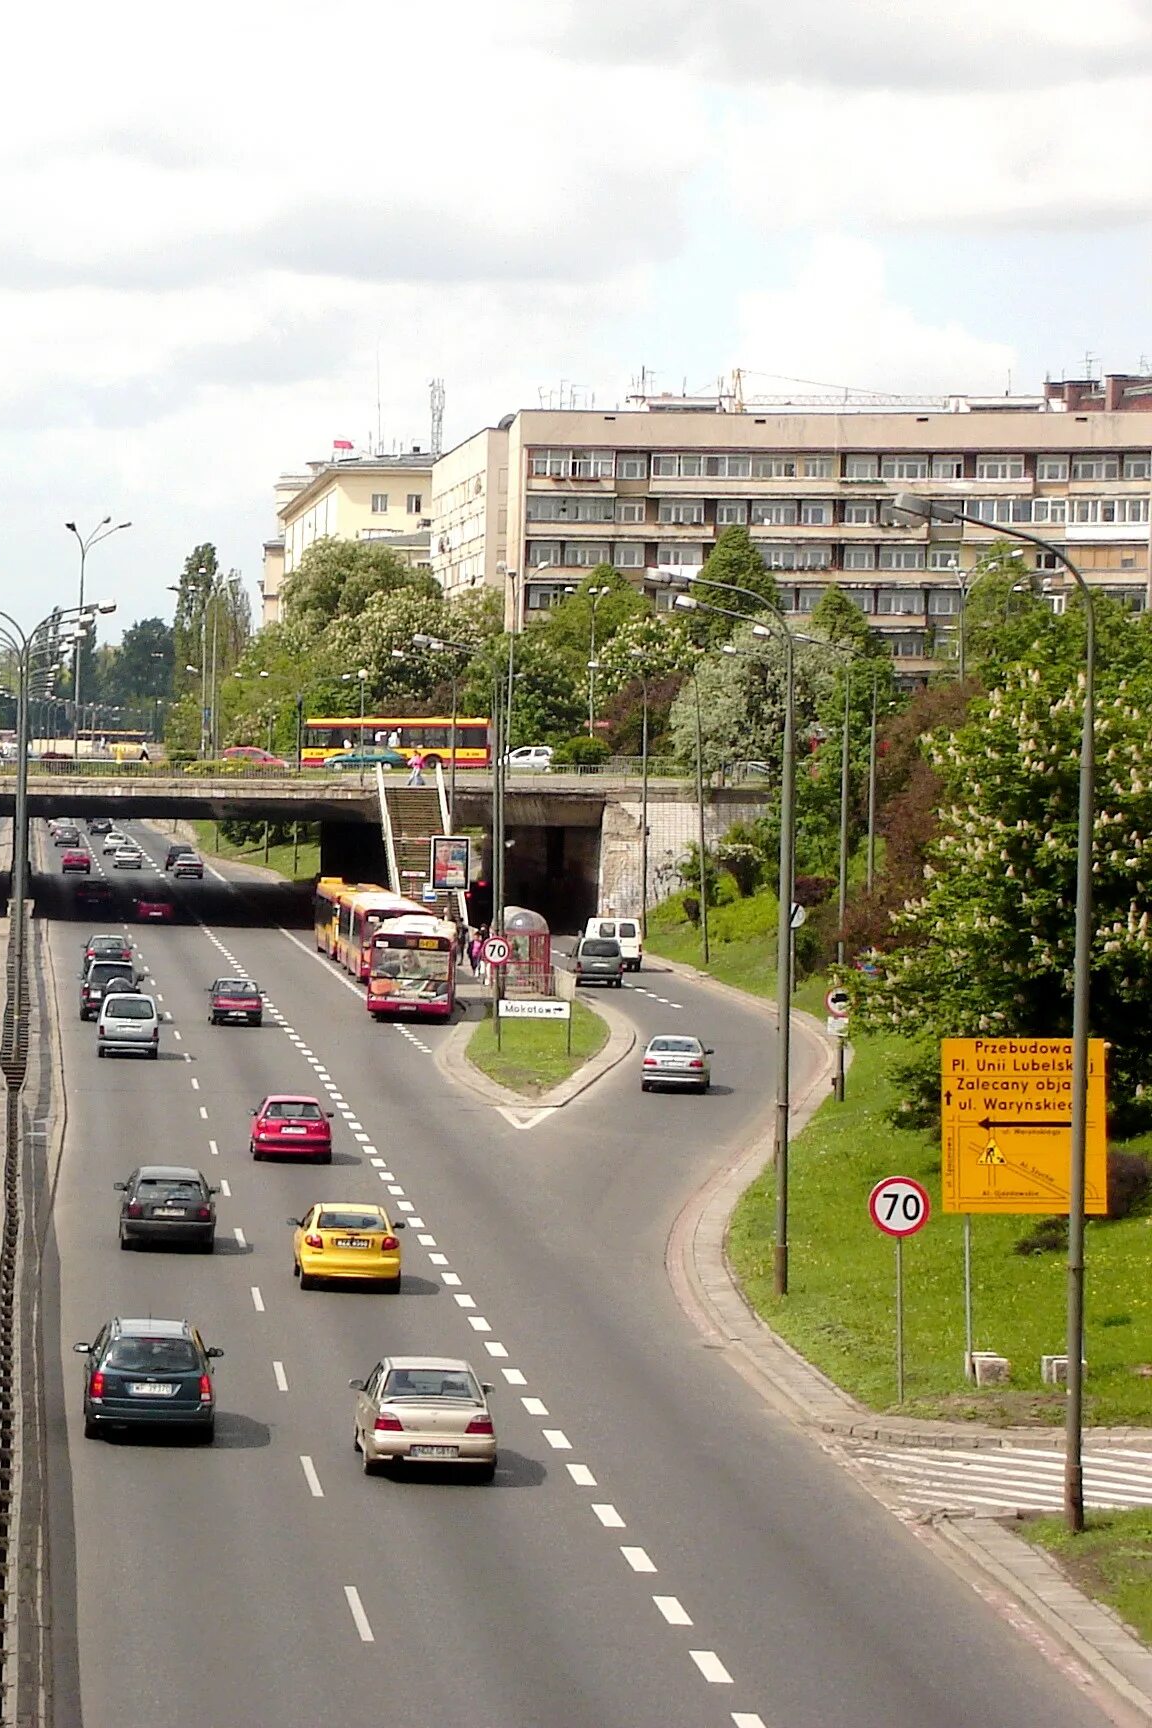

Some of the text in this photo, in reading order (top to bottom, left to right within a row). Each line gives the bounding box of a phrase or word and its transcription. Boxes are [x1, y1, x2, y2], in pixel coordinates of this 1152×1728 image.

[488, 944, 506, 958] 70
[975, 1040, 1072, 1054] Przebudowa
[952, 1058, 1094, 1074] Pl. Unii Lubelskj
[957, 1078, 1073, 1094] Zalecany obja
[959, 1098, 1073, 1114] ul. Waryńskie
[883, 1194, 920, 1221] 70
